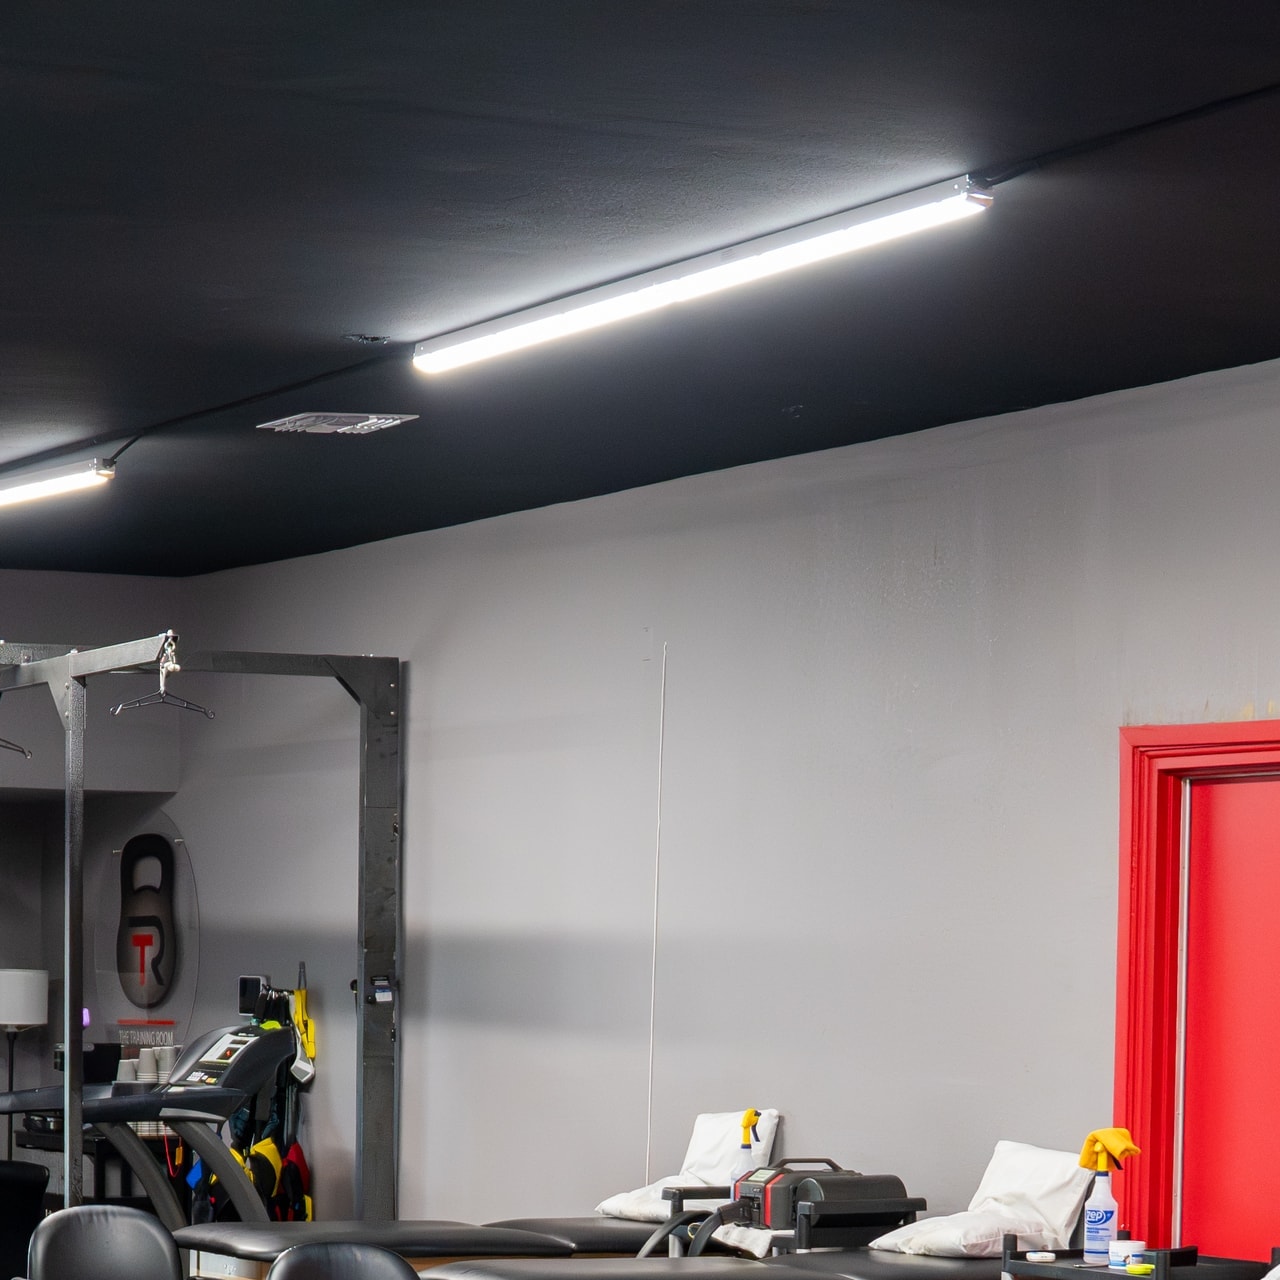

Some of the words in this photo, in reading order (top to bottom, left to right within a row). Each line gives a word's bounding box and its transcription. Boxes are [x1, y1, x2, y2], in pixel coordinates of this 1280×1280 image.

[119, 1030, 129, 1045] THE
[130, 1030, 155, 1046] TRAINING
[155, 1031, 174, 1046] ROOM
